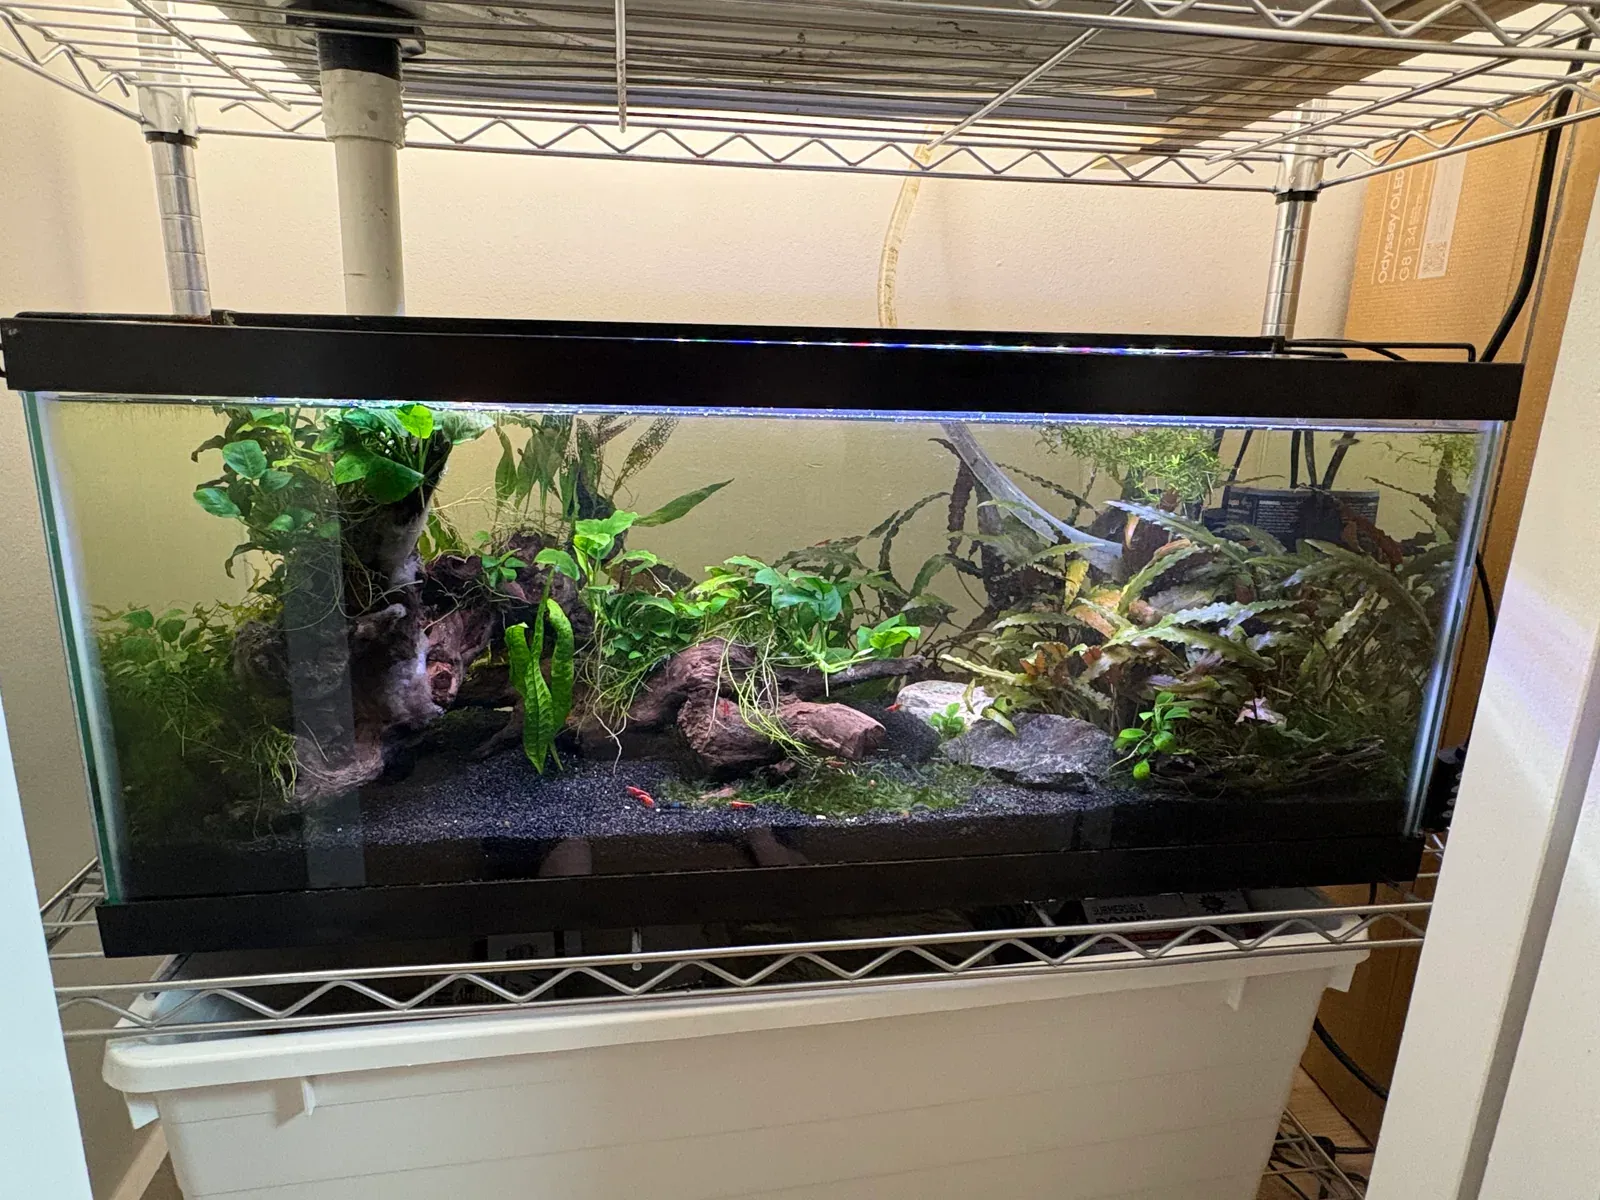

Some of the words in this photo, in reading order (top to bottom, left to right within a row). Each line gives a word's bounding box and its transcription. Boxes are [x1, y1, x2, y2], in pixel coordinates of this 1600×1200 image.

[1378, 213, 1400, 283] Odyssey
[1390, 169, 1405, 209] OLED
[1404, 226, 1418, 246] 34
[1399, 255, 1412, 281] G8
[1091, 903, 1147, 915] SUBMERSIBLE
